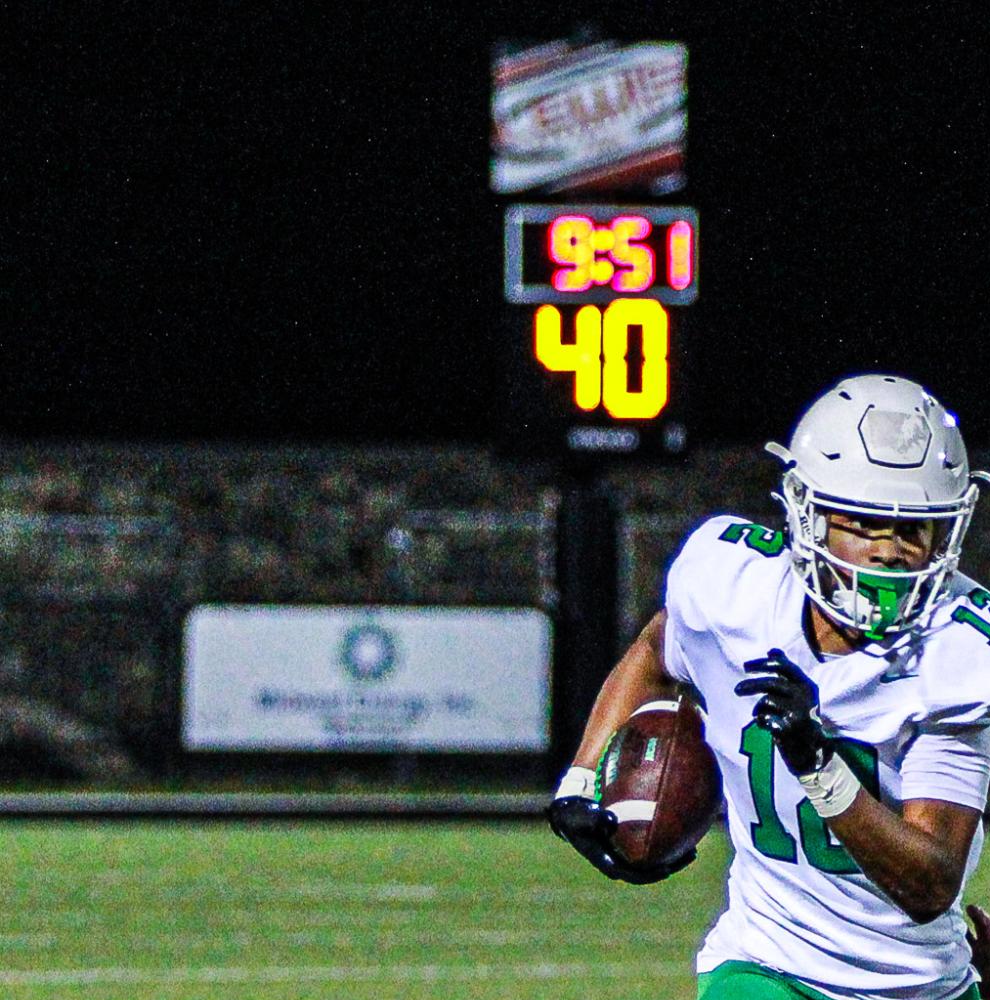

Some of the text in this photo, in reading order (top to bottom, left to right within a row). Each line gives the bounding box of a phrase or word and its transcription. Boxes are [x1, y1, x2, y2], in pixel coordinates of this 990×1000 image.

[547, 214, 693, 292] 9:51
[534, 297, 669, 419] 40
[718, 521, 786, 558] 2
